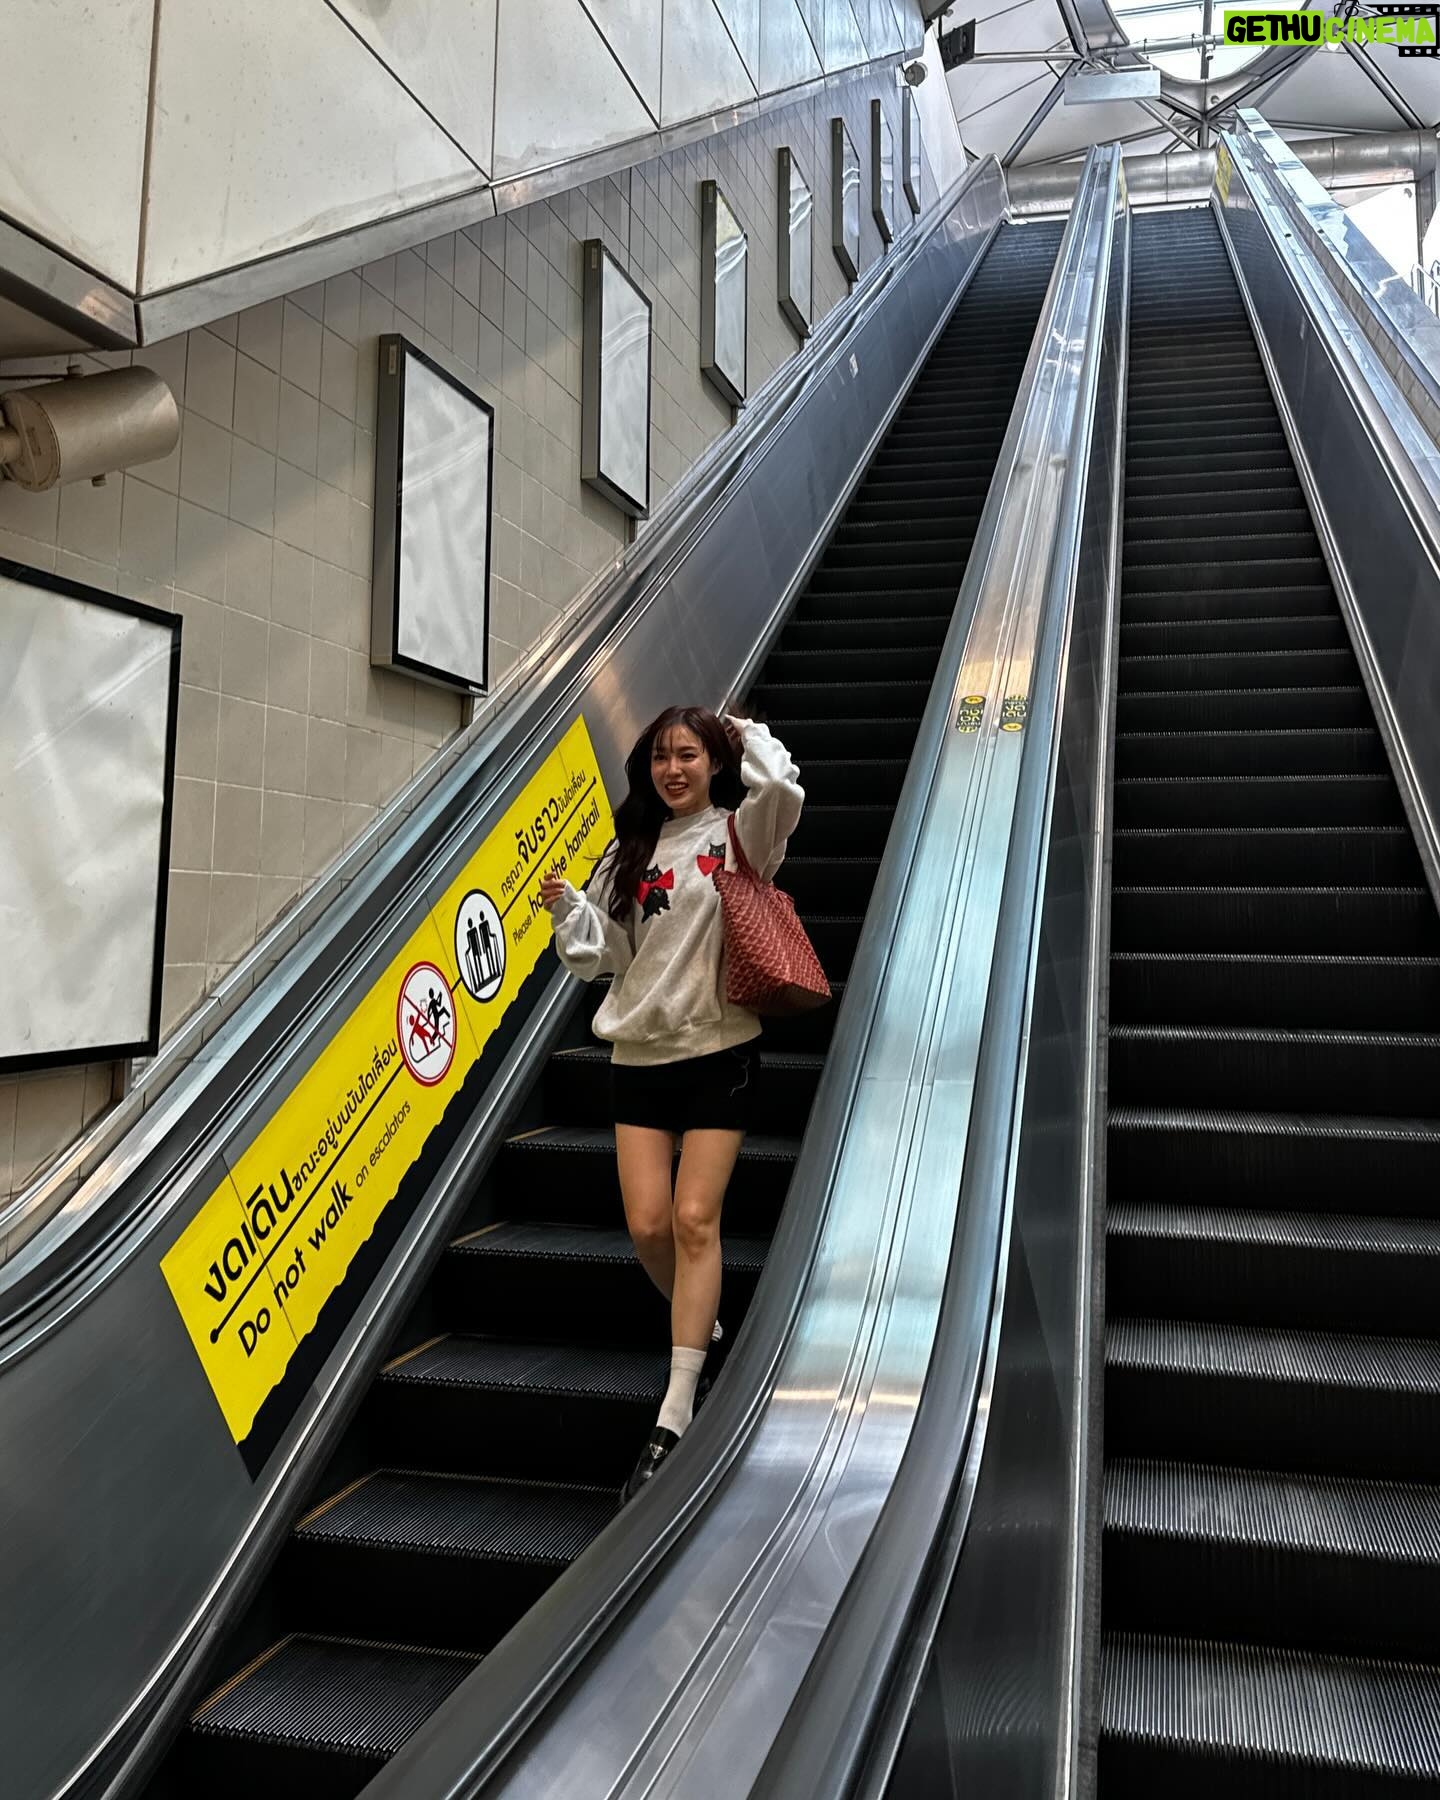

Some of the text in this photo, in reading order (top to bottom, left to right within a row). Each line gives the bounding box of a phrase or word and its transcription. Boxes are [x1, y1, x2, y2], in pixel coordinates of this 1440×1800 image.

[512, 914, 532, 946] Please
[564, 797, 600, 862] handrail
[237, 1101, 411, 1358] Do not walk on escalators
